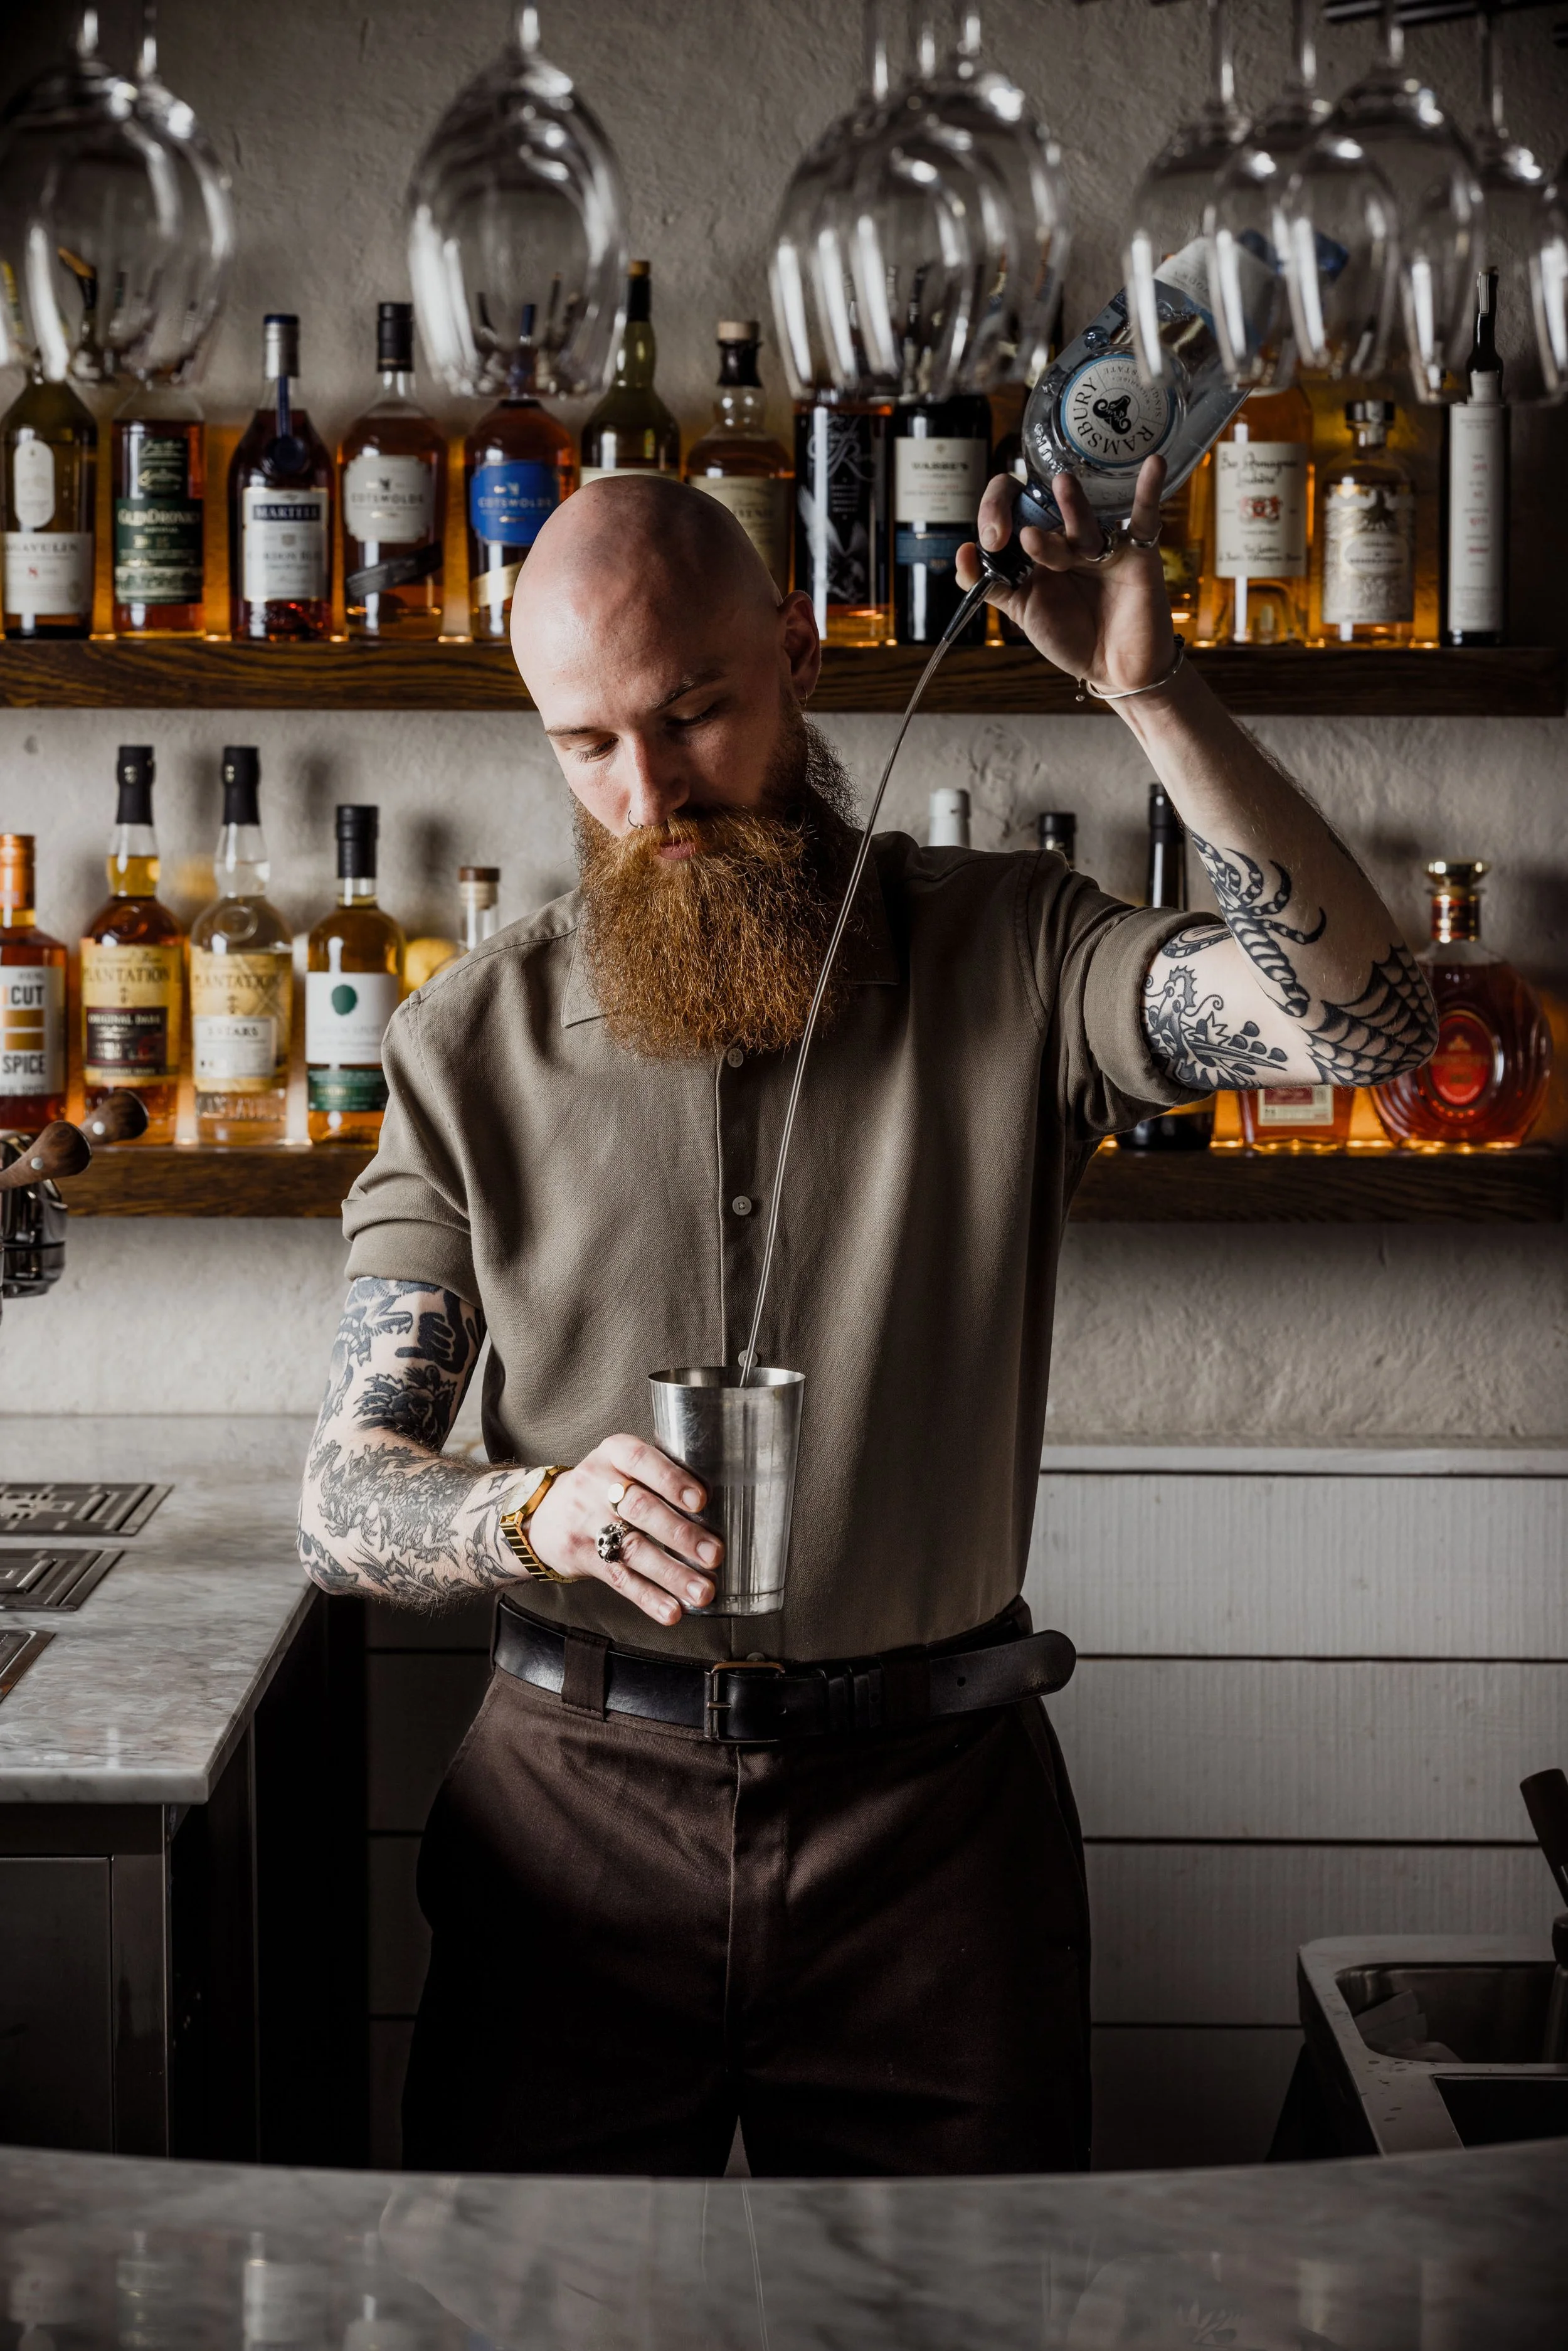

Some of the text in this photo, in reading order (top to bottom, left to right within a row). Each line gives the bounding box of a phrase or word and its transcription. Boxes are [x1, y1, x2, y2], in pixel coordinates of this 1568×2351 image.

[1073, 377, 1155, 455] RAMSBURY
[11, 985, 45, 1005] CUT
[3, 1054, 45, 1075] SPICE
